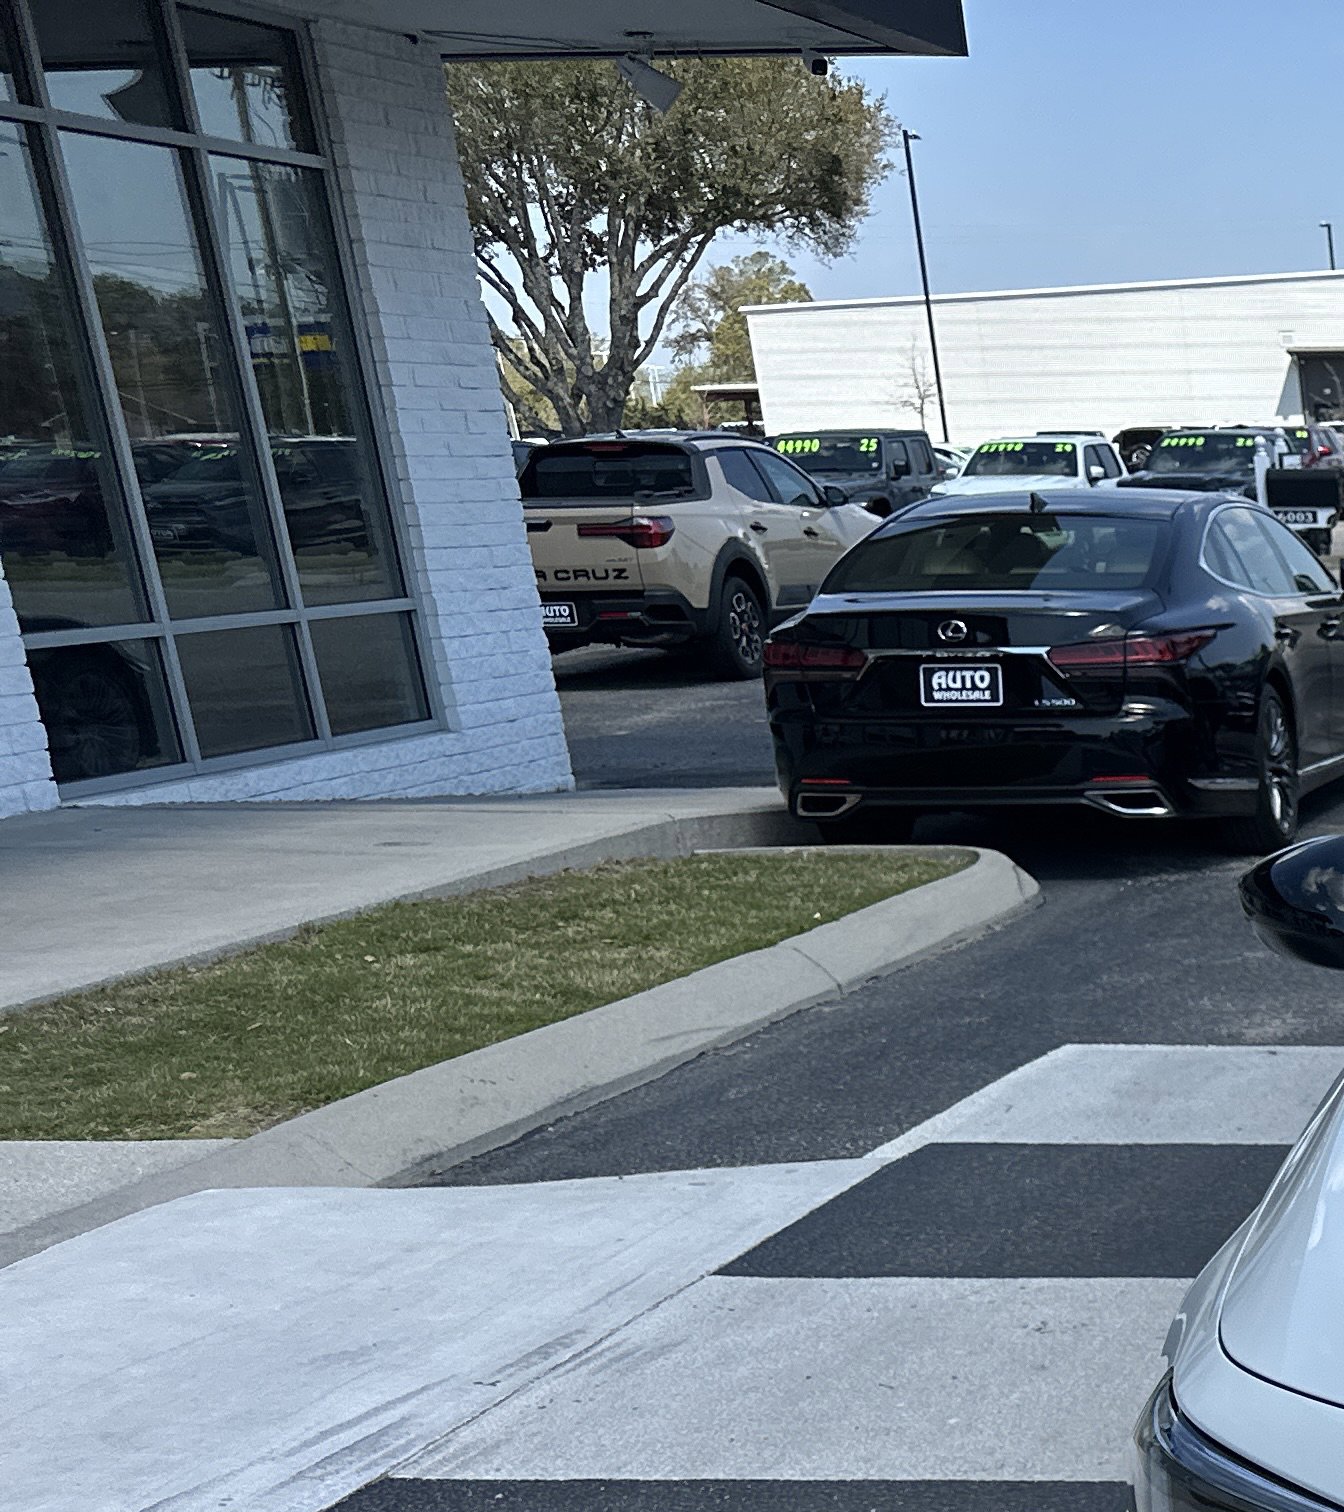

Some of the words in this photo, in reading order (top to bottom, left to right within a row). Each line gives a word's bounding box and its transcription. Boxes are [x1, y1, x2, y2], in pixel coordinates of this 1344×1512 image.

[860, 438, 878, 452] 25
[553, 568, 630, 582] CRUZ
[932, 670, 991, 690] AUTO
[932, 690, 991, 701] WHOLESALE
